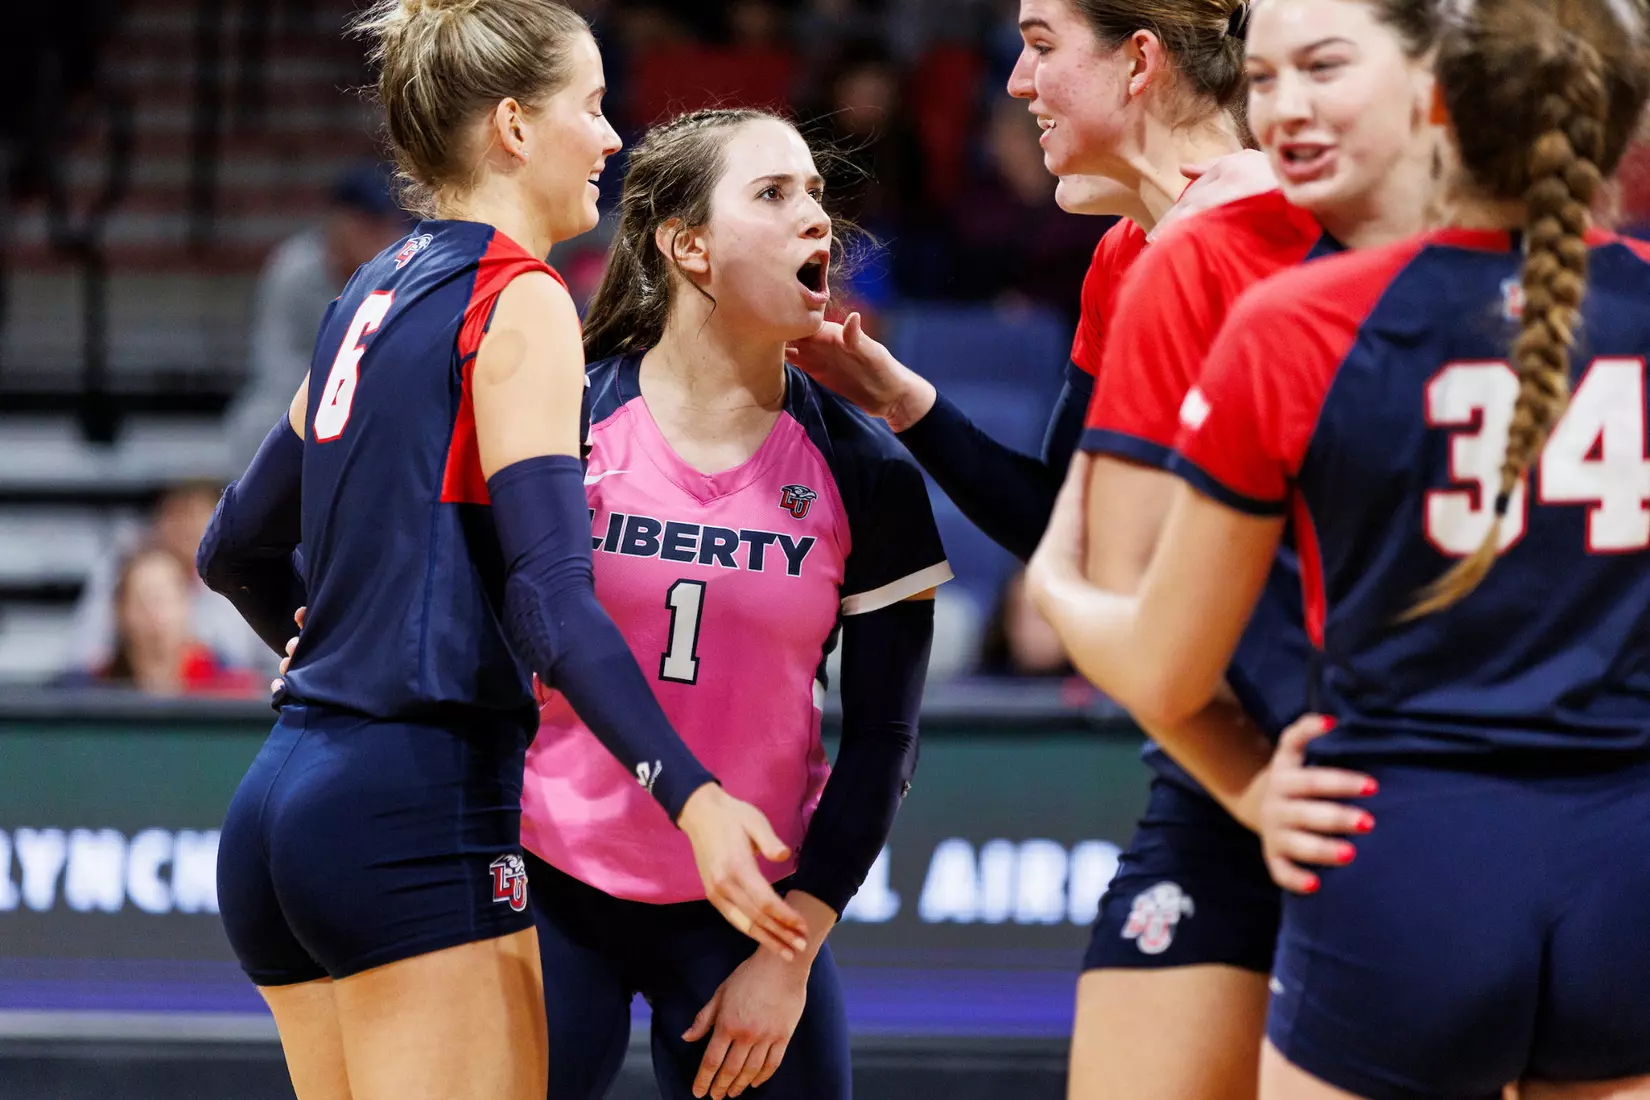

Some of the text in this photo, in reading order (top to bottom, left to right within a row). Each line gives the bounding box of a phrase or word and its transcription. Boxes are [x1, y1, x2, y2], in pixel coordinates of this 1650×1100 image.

[313, 288, 396, 443] 6
[778, 486, 815, 520] LU
[1423, 356, 1650, 556] 34
[658, 578, 706, 686] 1
[489, 860, 528, 911] LU
